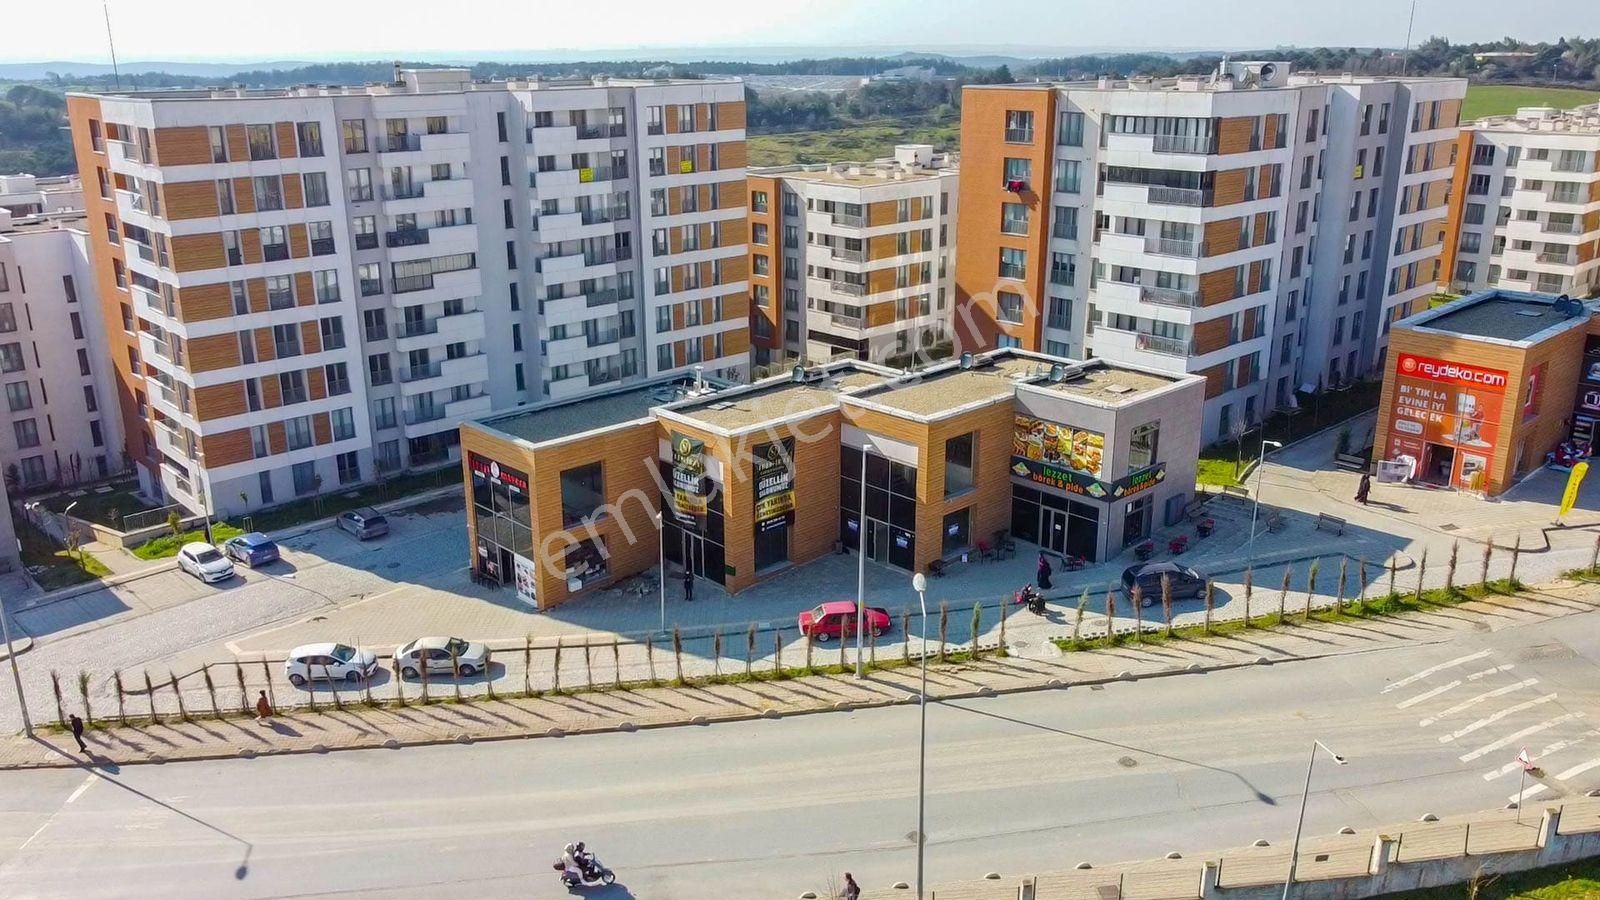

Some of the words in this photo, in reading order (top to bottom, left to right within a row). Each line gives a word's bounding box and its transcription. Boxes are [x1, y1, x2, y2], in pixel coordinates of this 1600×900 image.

[1417, 362, 1505, 386] reydeko.com
[1043, 465, 1072, 482] lezzet
[1057, 479, 1064, 488] &
[1065, 482, 1084, 496] pide
